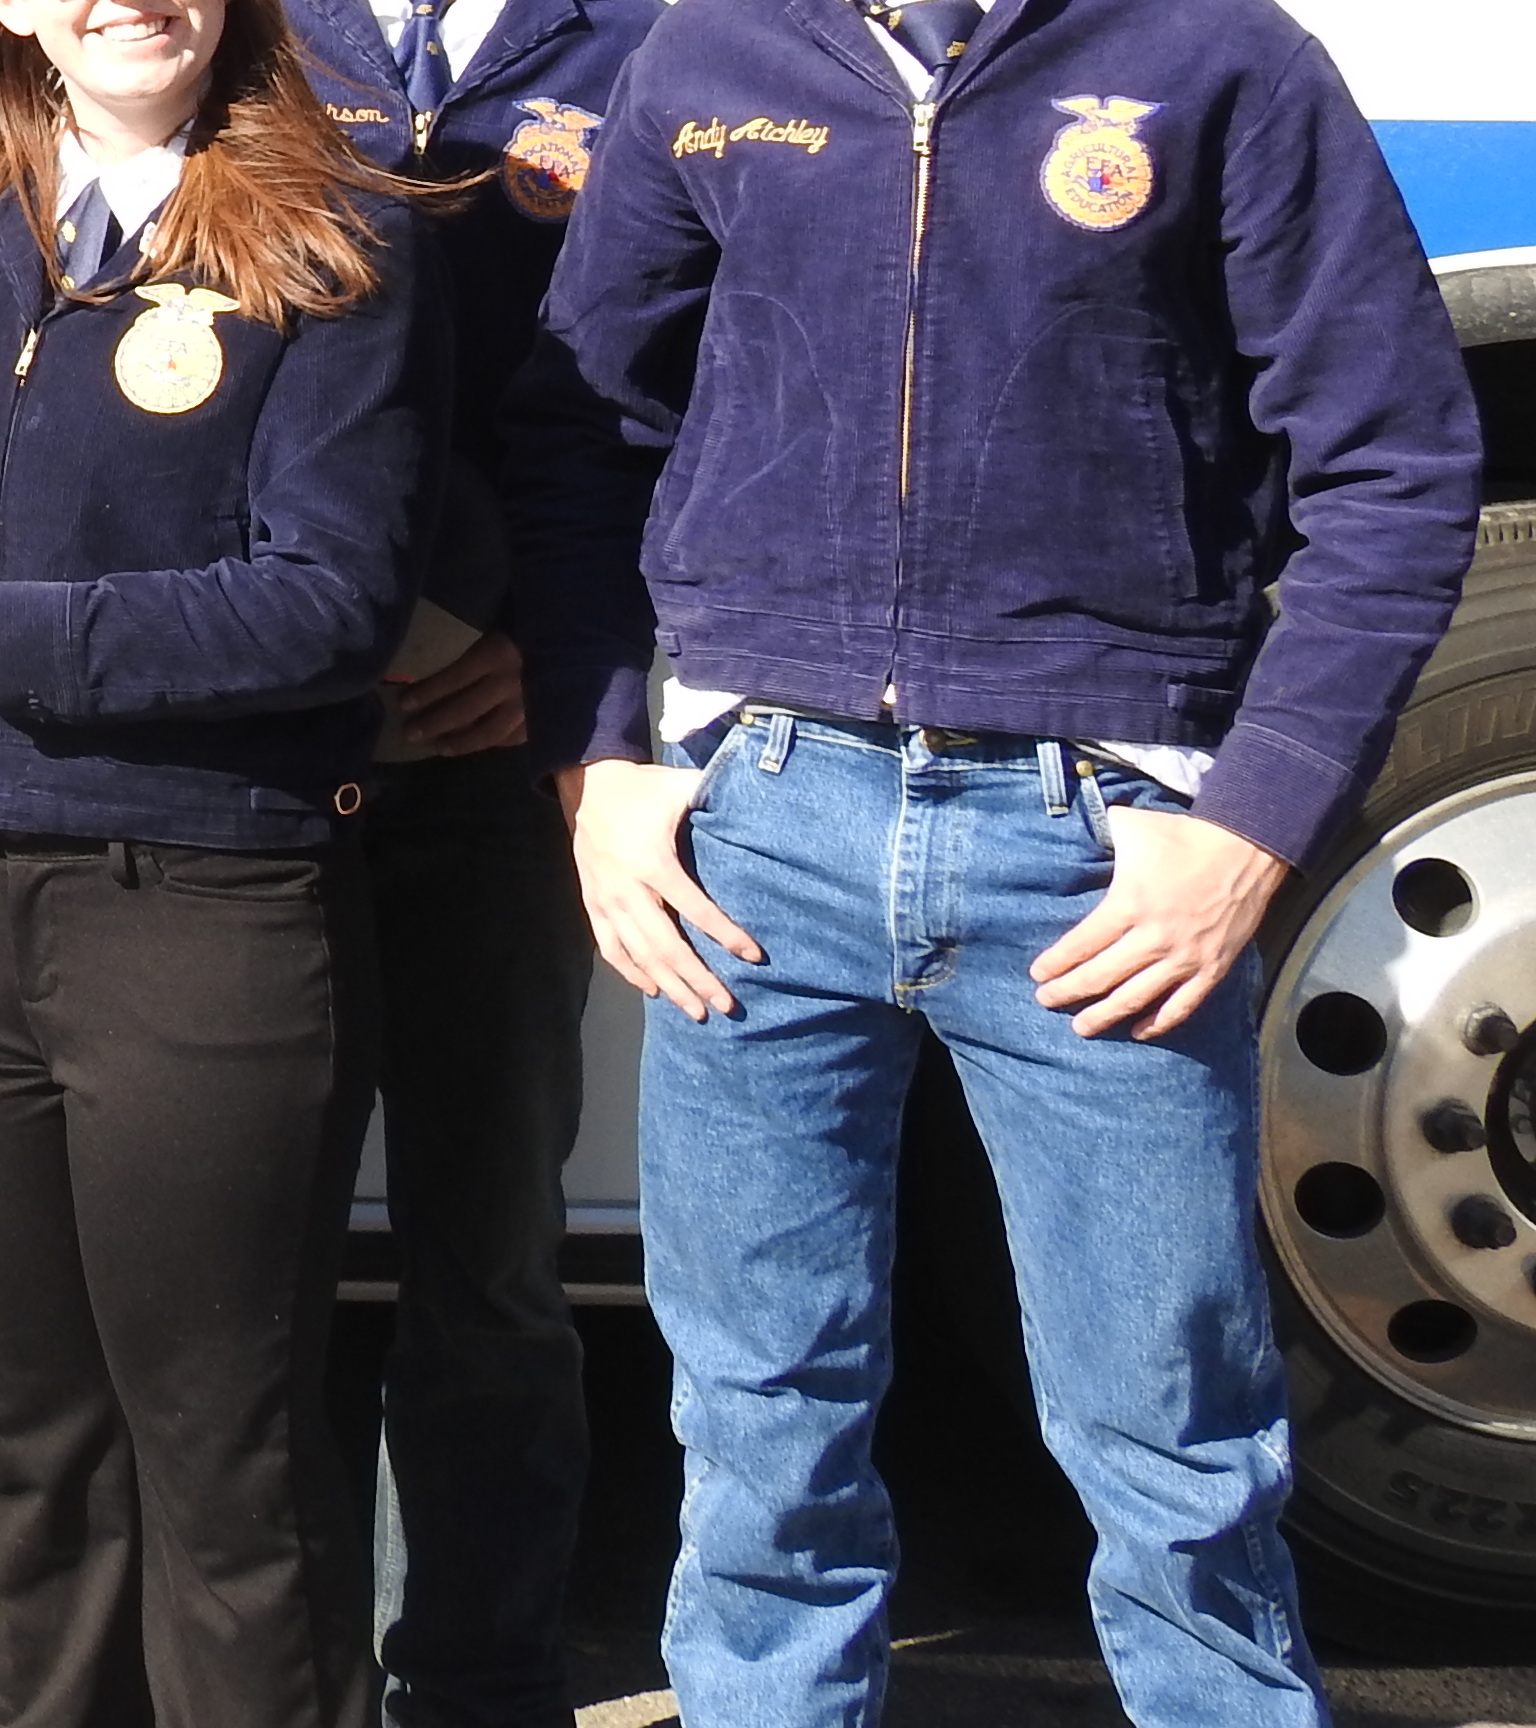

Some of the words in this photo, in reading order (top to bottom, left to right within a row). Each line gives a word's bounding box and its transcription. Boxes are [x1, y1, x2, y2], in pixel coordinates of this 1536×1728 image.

[672, 115, 727, 159] Andy
[729, 115, 830, 156] Atchley
[1061, 142, 1137, 184] AGRICULTURAL
[1065, 189, 1134, 214] EDUCATION
